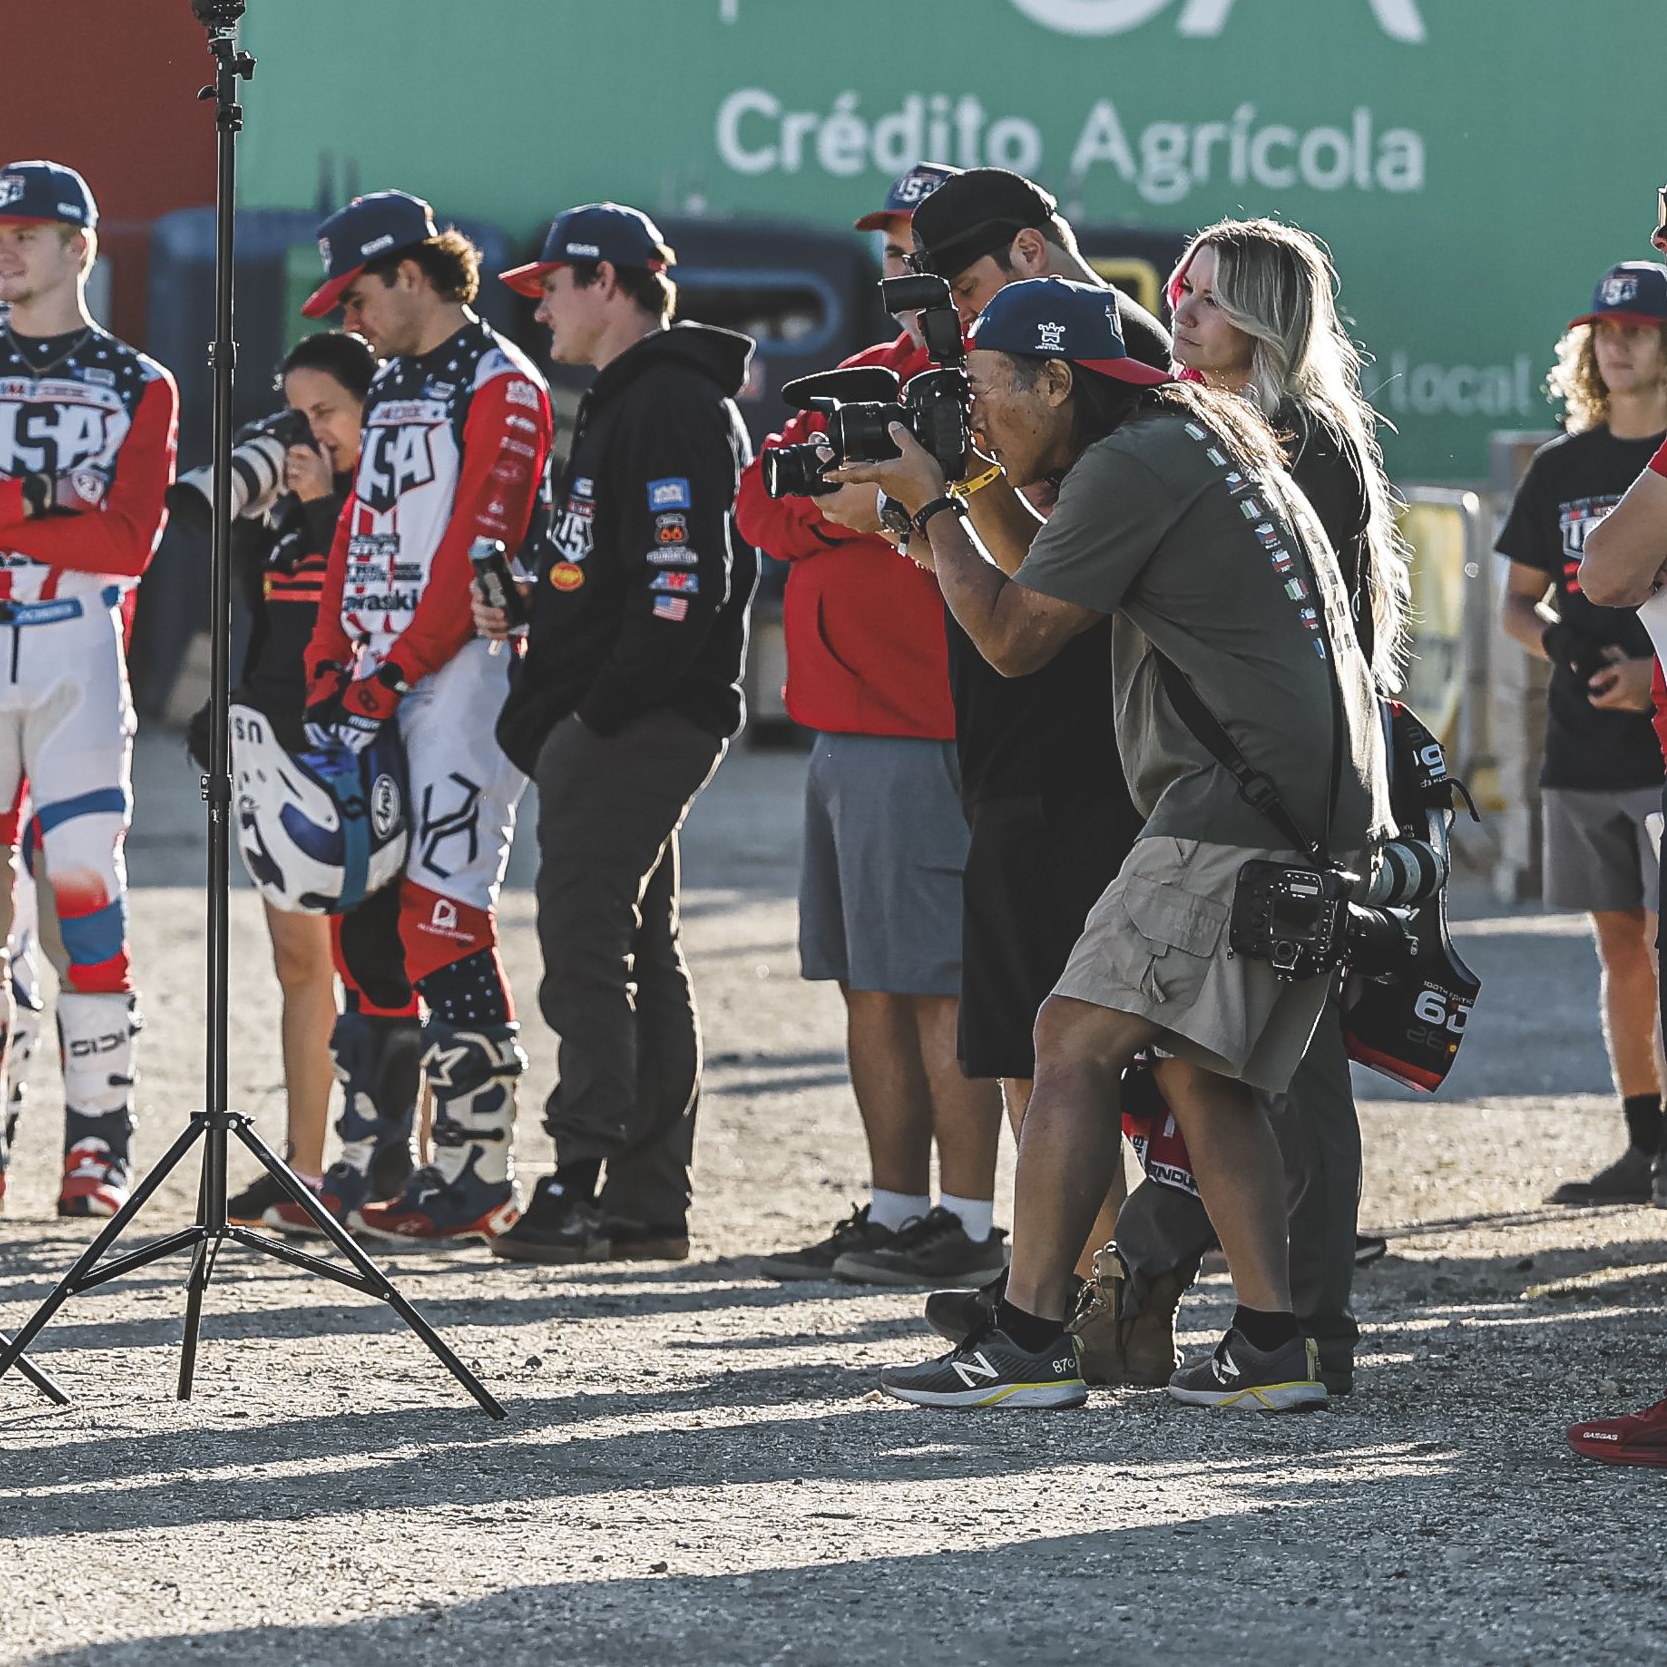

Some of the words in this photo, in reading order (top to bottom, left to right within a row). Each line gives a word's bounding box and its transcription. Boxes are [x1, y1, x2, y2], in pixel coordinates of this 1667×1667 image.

[715, 88, 1042, 176] Crédito
[1070, 100, 1426, 205] Agrícola
[1388, 350, 1532, 417] local
[1582, 1431, 1619, 1441] GASGAS
